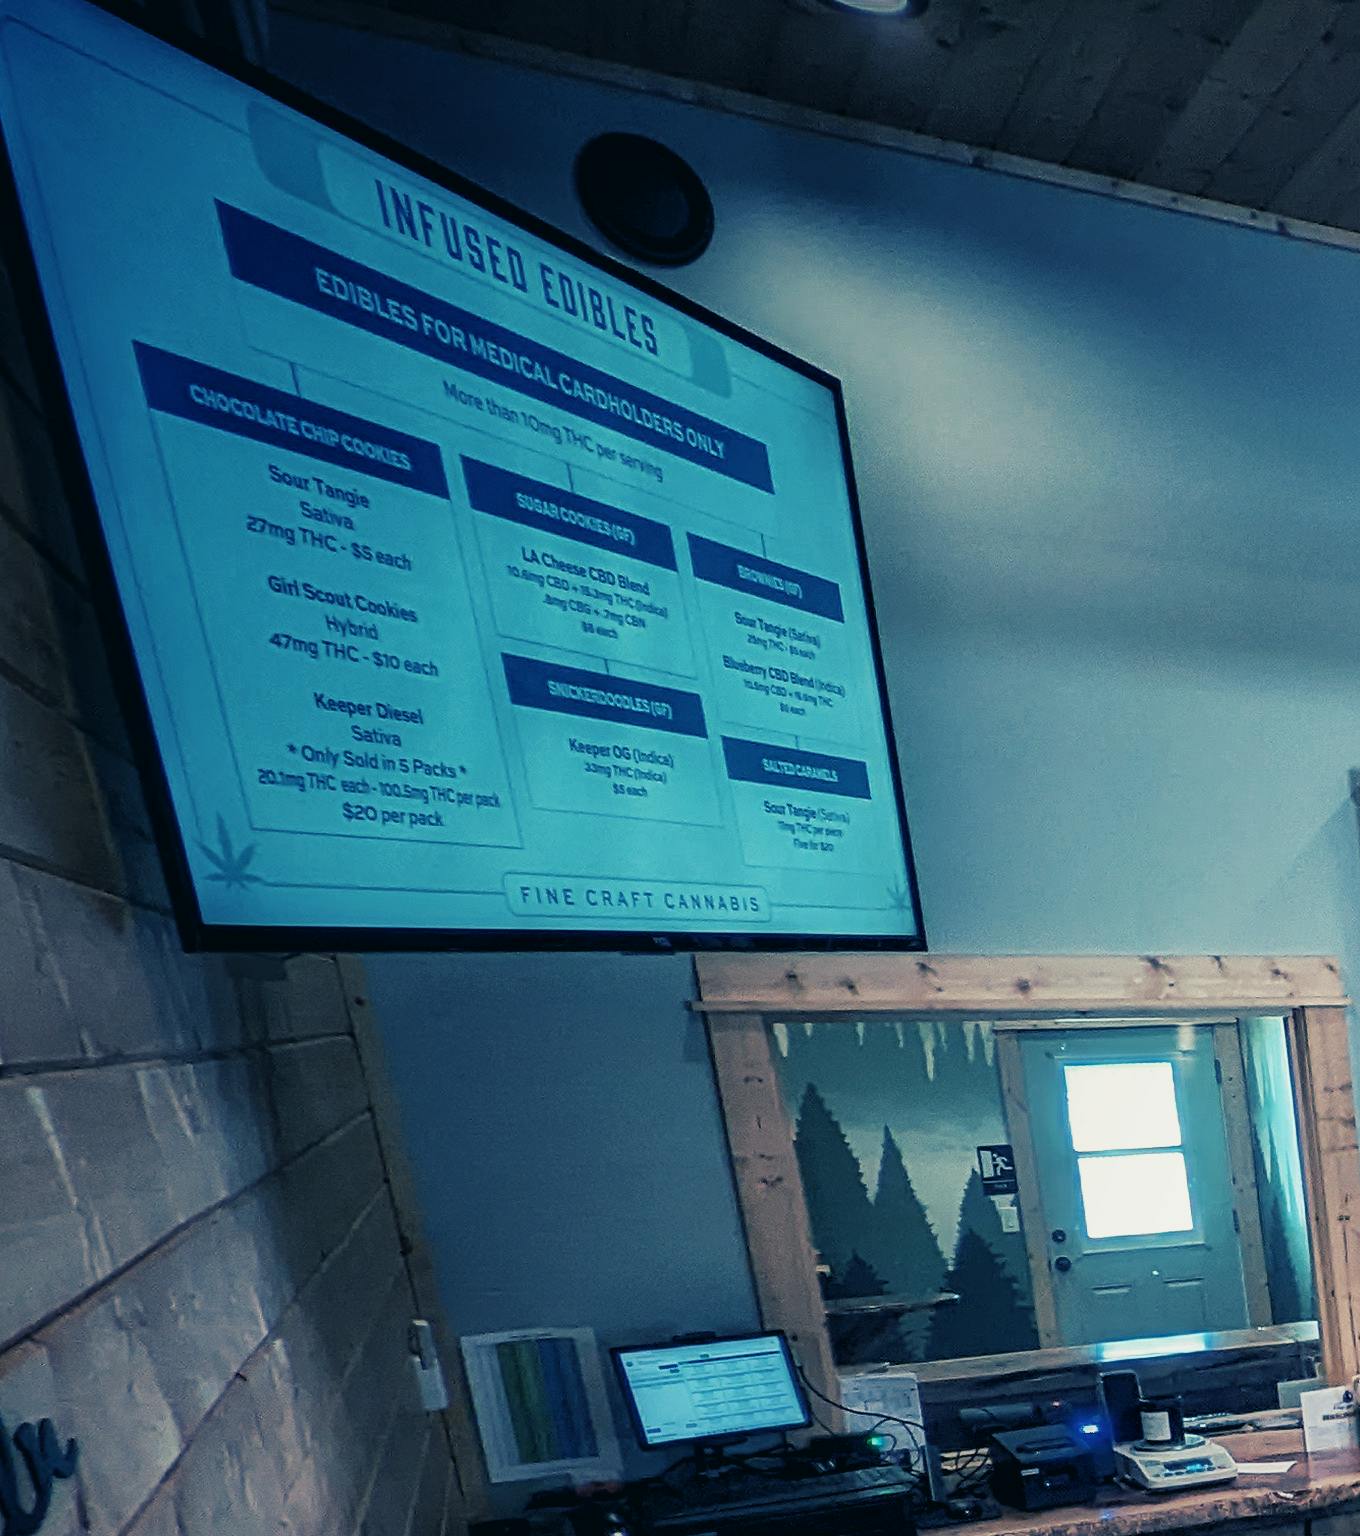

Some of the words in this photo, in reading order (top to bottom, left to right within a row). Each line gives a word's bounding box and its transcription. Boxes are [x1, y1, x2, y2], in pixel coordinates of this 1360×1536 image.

[374, 178, 529, 294] INFUSED
[539, 261, 660, 357] EDIBLES
[314, 266, 419, 332] EDIBLES
[422, 313, 469, 354] FOR
[468, 332, 558, 392] MEDICAL
[557, 370, 684, 444] CARDHOLDERS
[685, 427, 727, 460] ONLY
[188, 382, 300, 437] CHOCOLATE
[299, 420, 341, 449] CHIP
[340, 435, 412, 472] COOKIES
[442, 379, 487, 413] More
[488, 396, 519, 426] than
[519, 411, 562, 446] 10mg
[563, 424, 595, 453] THC
[596, 439, 619, 465] per
[618, 447, 665, 484] serving
[267, 463, 311, 495] Sour
[311, 475, 370, 509] Tangie
[299, 501, 356, 531] Sativa
[514, 491, 562, 520] SUGAR
[559, 505, 613, 538] COOKIES
[246, 514, 296, 547] 27mg
[297, 525, 338, 554] THC
[351, 541, 374, 565] $5
[373, 546, 413, 571] each
[521, 546, 541, 566] LA
[540, 552, 589, 579] Cheese
[587, 566, 617, 587] CBD
[616, 575, 652, 597] Blend
[546, 574, 571, 593] CBD
[267, 575, 301, 599] Girl
[300, 580, 355, 611] Scout
[354, 594, 419, 624] Cookies
[324, 613, 380, 642] Hybrid
[268, 632, 321, 660] 47mg
[322, 639, 360, 663] THC
[372, 649, 401, 671] $10
[402, 657, 440, 678] each
[312, 691, 373, 721] Keeper
[375, 702, 425, 727] Diesel
[547, 680, 651, 713] SNICKERDOODLES
[350, 725, 402, 748] Sativa
[568, 736, 612, 760] Keeper
[611, 745, 632, 760] OG
[631, 748, 675, 769] (Indica)
[300, 744, 340, 769] Only
[342, 750, 380, 771] Sold
[380, 755, 397, 772] in
[399, 756, 411, 773] 5
[411, 758, 458, 779] Packs
[306, 772, 337, 793] THC
[341, 777, 371, 795] each
[429, 786, 456, 805] THC
[474, 790, 502, 810] pack
[342, 800, 379, 822] $20
[381, 806, 408, 827] per
[409, 808, 446, 828] pack
[519, 886, 576, 907] FINE
[585, 889, 655, 909] CRAFT
[662, 892, 761, 914] CANNABIS
